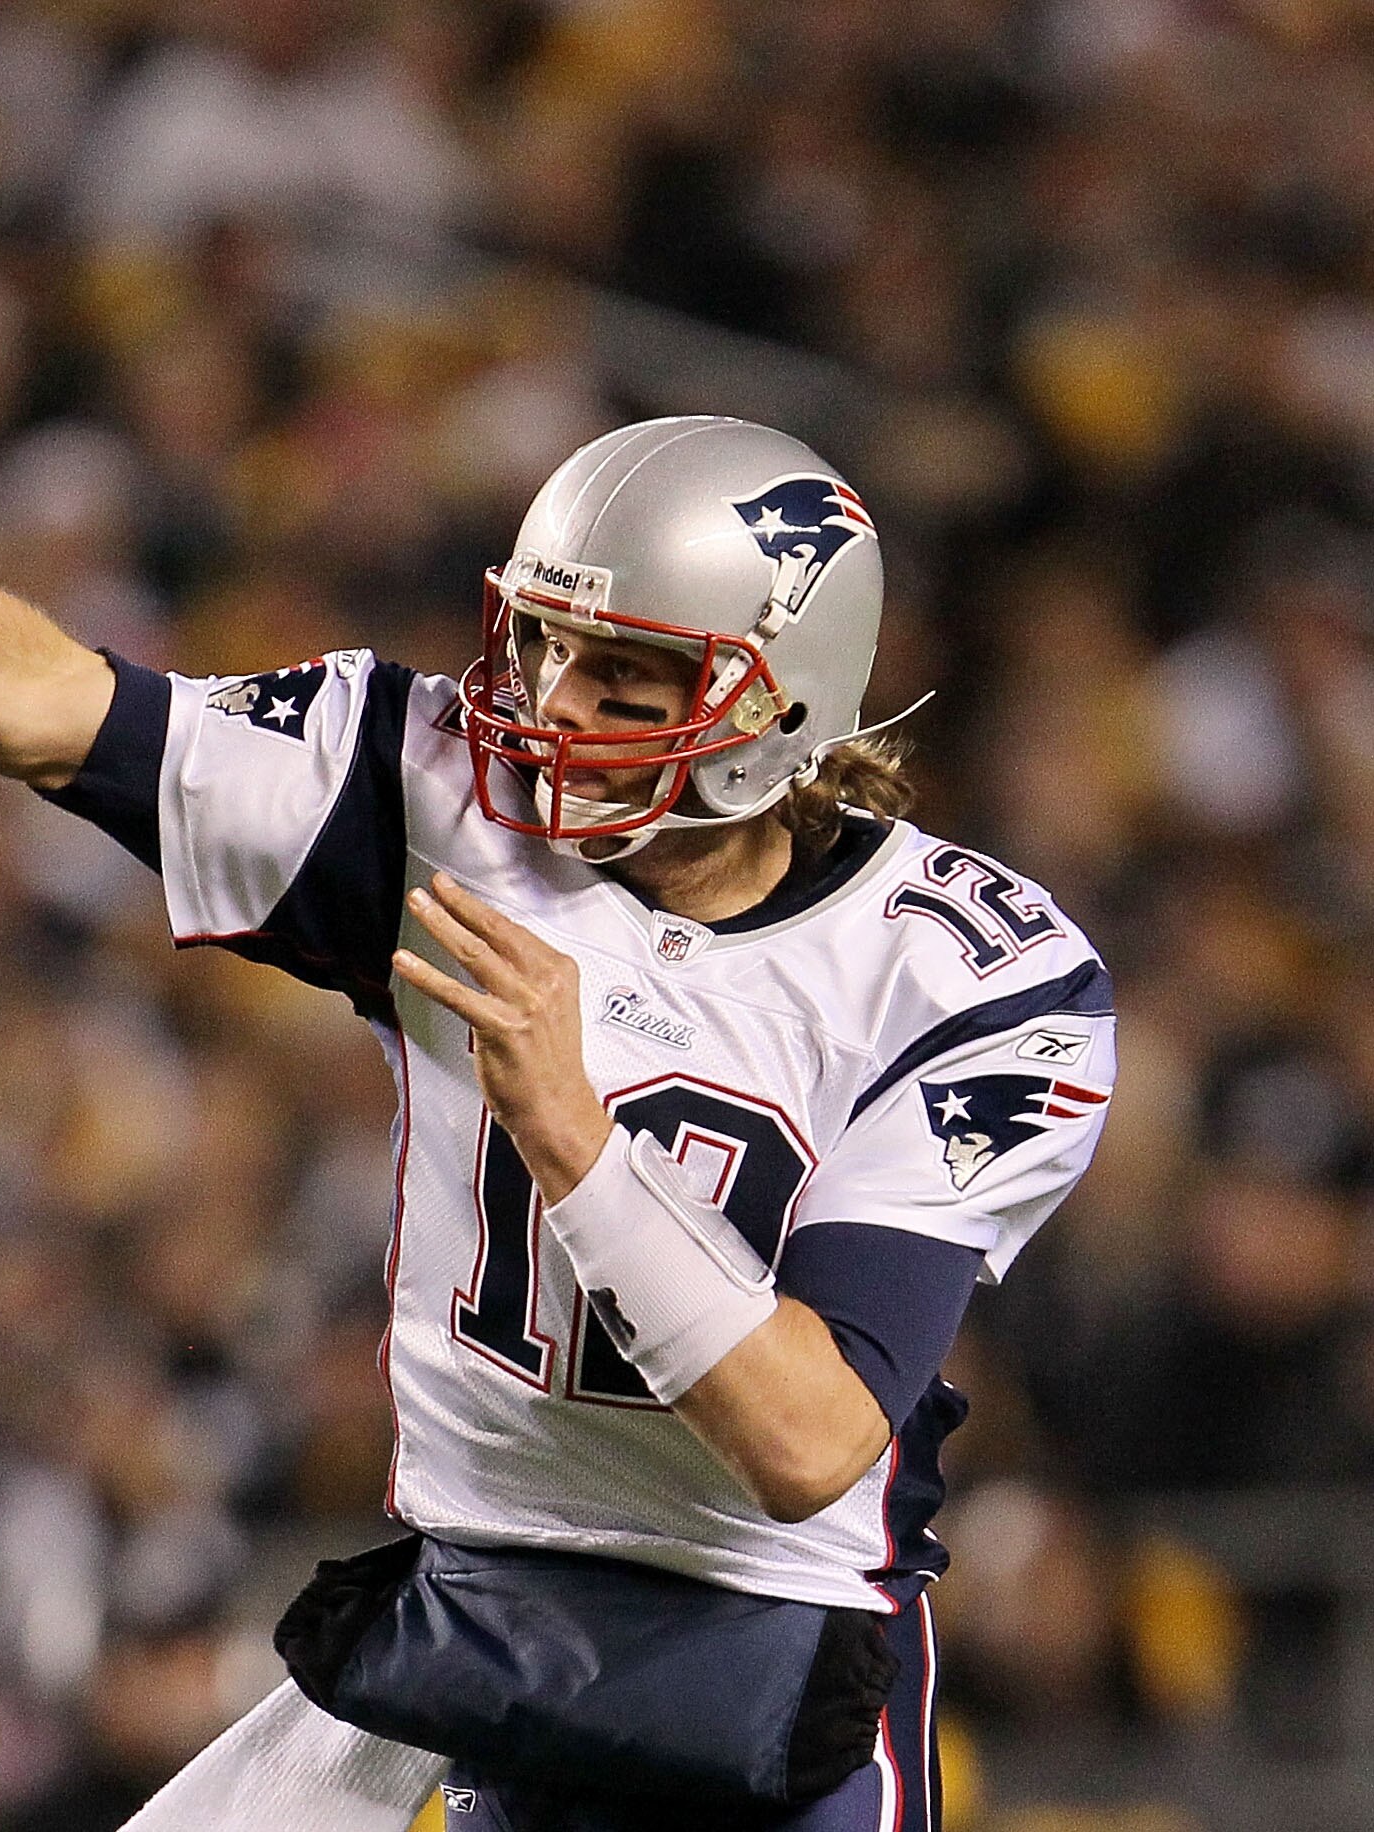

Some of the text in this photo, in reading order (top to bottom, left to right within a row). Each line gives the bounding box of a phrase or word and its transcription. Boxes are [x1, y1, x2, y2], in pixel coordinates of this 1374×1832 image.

[884, 843, 1067, 980] 12
[660, 939, 688, 958] NFL
[601, 993, 697, 1048] Patriots
